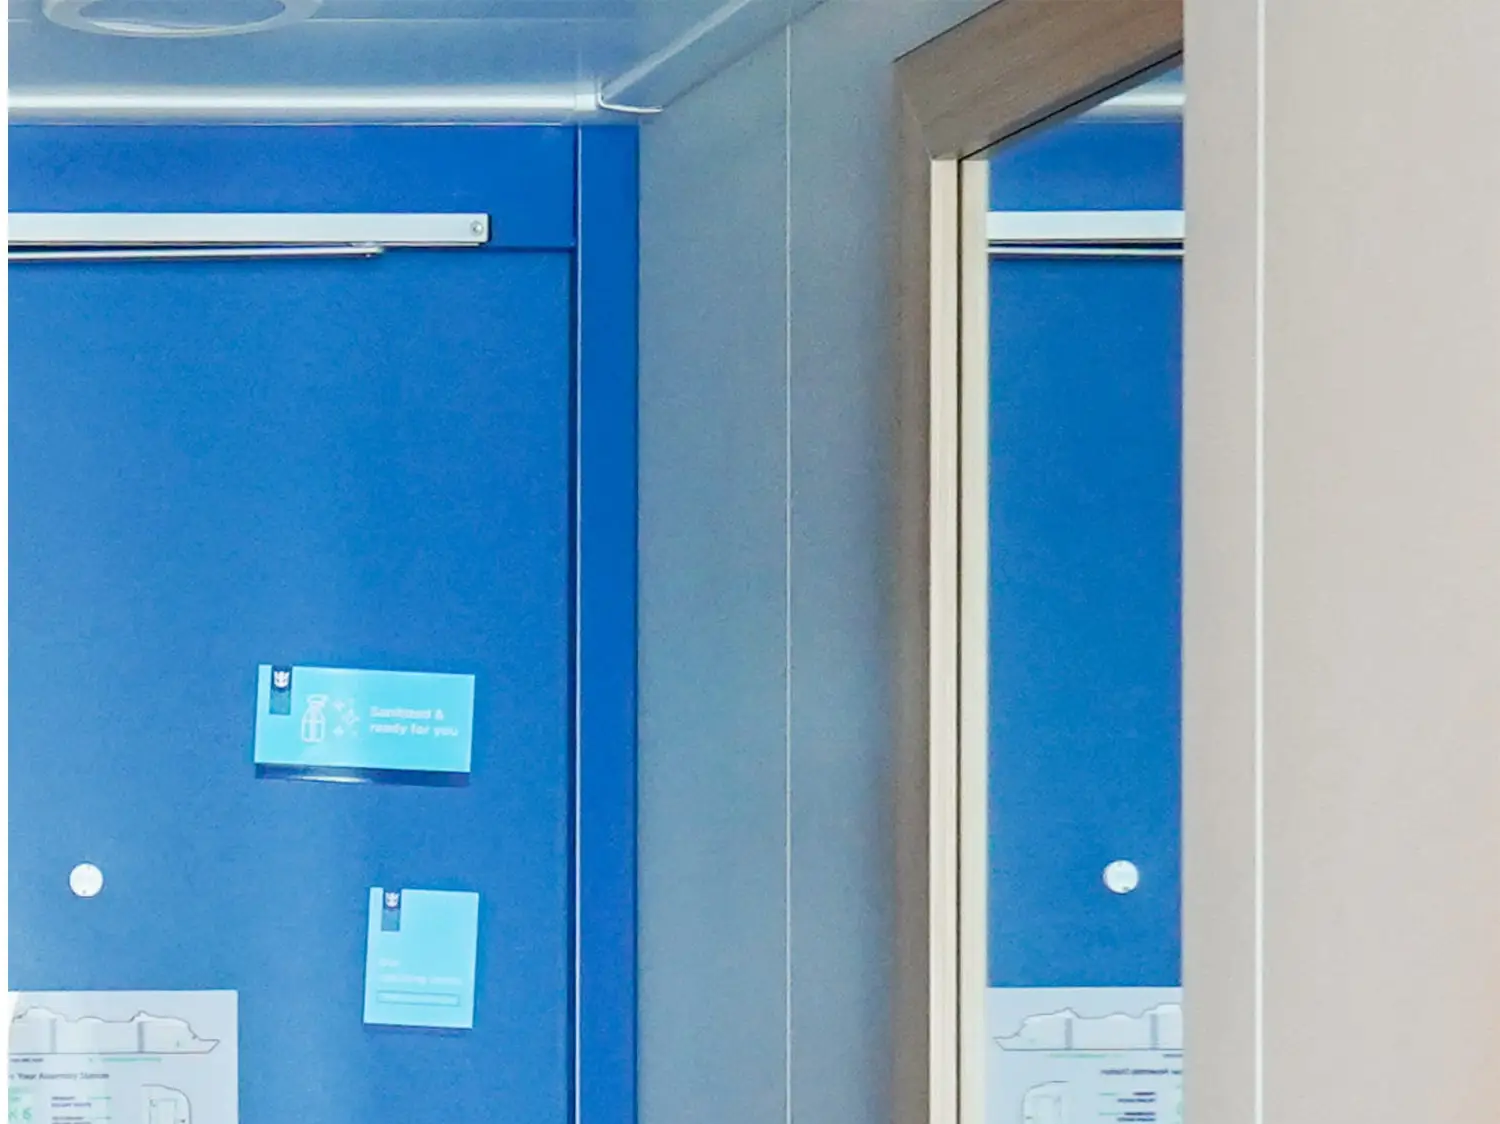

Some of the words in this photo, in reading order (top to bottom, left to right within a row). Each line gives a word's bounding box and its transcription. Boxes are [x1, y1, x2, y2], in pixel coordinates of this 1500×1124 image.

[369, 723, 408, 736] ready
[410, 723, 430, 736] for
[433, 726, 459, 738] you
